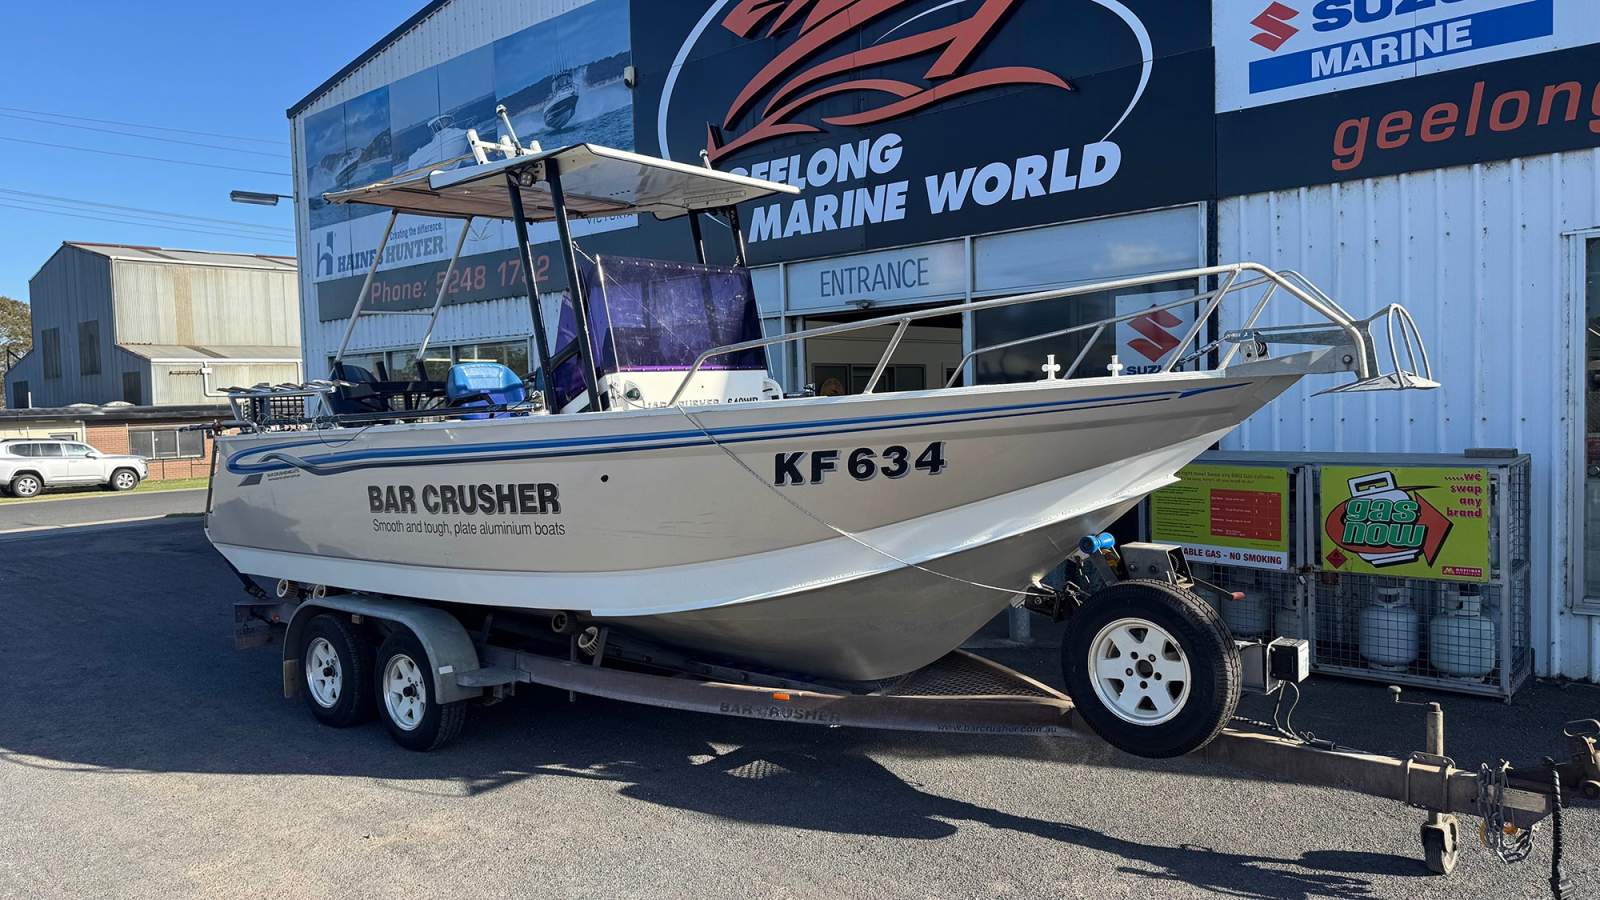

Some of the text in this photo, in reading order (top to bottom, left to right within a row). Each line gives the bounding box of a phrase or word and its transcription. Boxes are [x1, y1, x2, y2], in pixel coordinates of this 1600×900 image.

[1311, 19, 1472, 78] MARINE
[729, 133, 903, 190] EELONG
[748, 140, 1122, 243] MARINE WORLD
[386, 235, 444, 263] HUNTER
[371, 255, 550, 304] Phone: 5248 172
[820, 257, 930, 298] ENTRANCE
[774, 441, 948, 486] KF 634
[368, 483, 562, 515] BAR CRUSHER
[1450, 484, 1482, 496] swap
[1459, 498, 1482, 508] any
[1344, 499, 1419, 523] gas
[1446, 507, 1482, 518] brand
[372, 518, 566, 538] Smooth and tough, plate aluminium boats
[1343, 521, 1427, 547] now
[1205, 549, 1221, 558] GAS
[1229, 552, 1241, 561] NO
[1243, 553, 1282, 565] SMOKING
[719, 702, 752, 715] BAR
